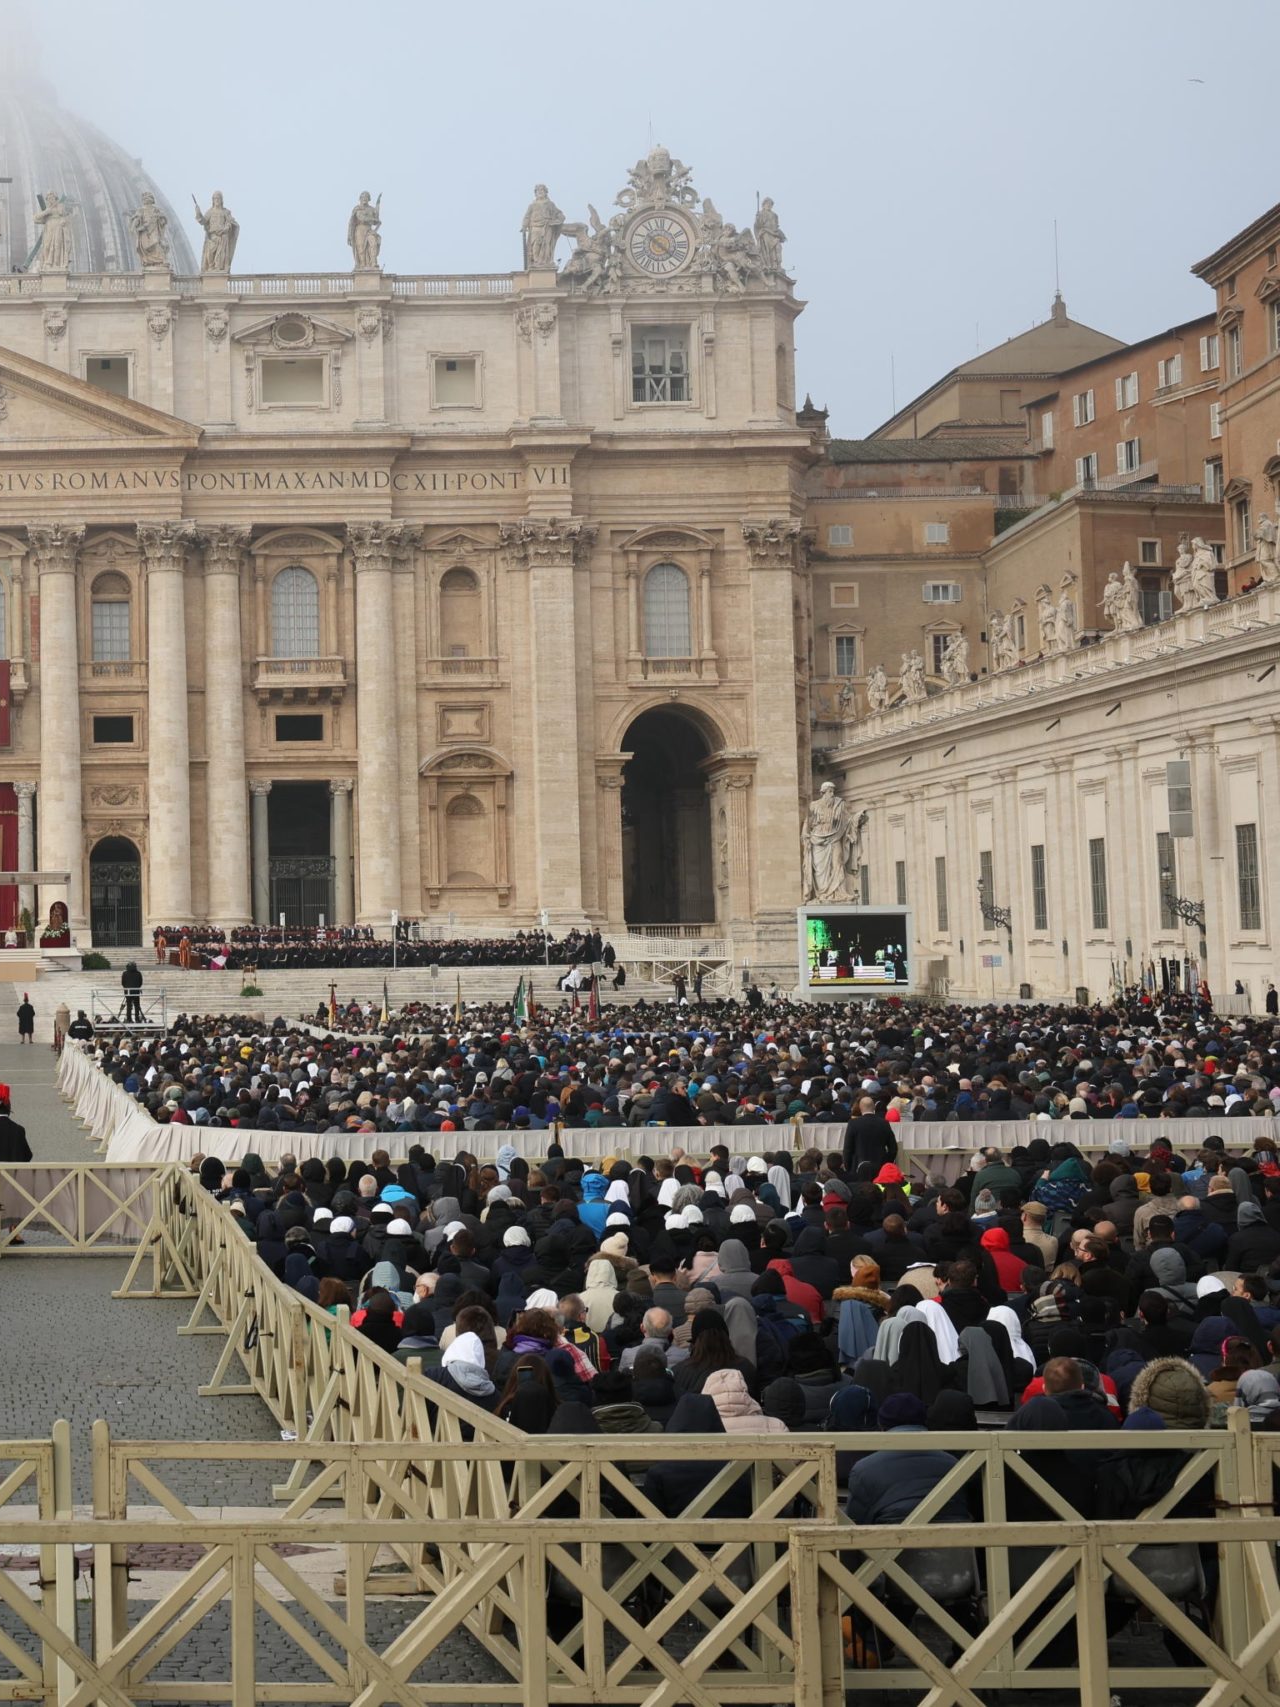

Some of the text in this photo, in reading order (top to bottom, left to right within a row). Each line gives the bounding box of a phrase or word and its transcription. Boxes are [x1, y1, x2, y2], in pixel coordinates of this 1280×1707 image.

[52, 470, 181, 490] ROMANVS
[187, 472, 250, 490] PONT
[253, 472, 308, 489] MAX
[312, 471, 344, 489] AN
[456, 472, 522, 491] PONT
[533, 467, 569, 484] VII
